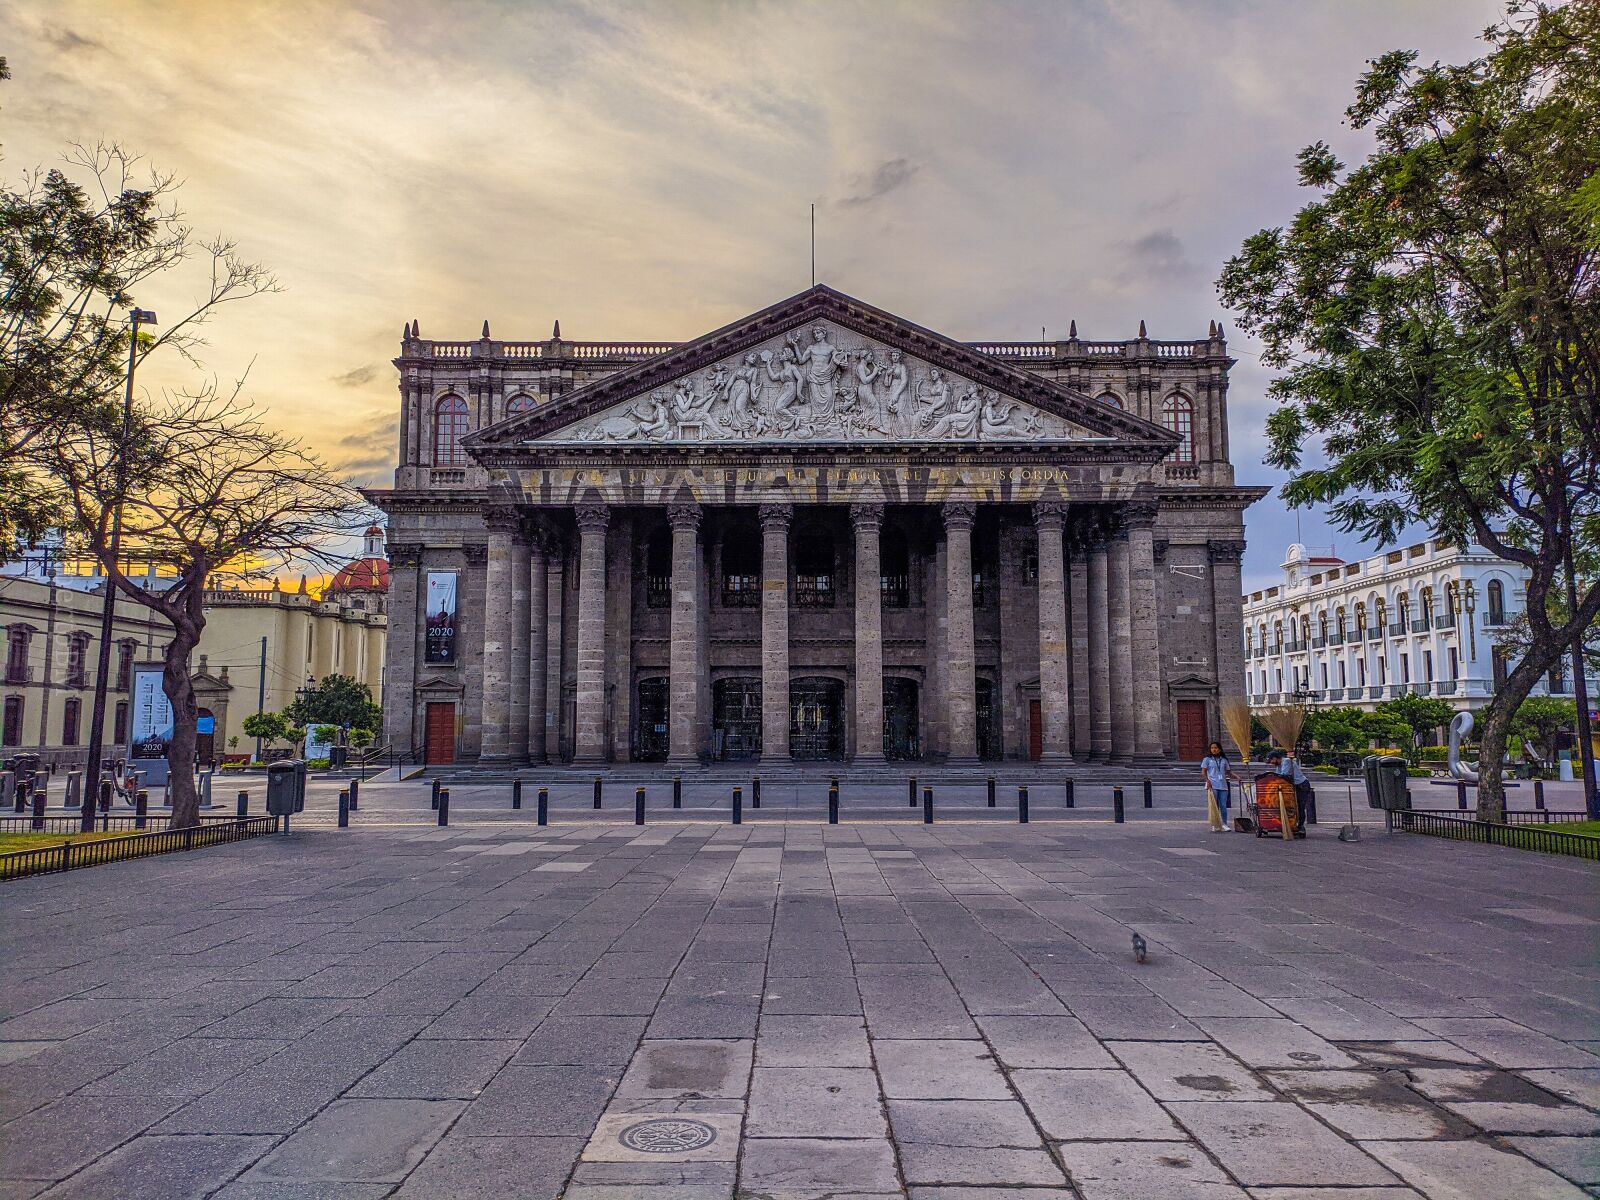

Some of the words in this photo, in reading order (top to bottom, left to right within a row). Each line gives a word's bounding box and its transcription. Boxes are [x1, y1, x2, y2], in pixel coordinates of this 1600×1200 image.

[981, 470, 1069, 480] DISCORDIA
[429, 627, 453, 637] 2020
[142, 743, 163, 751] 2020
